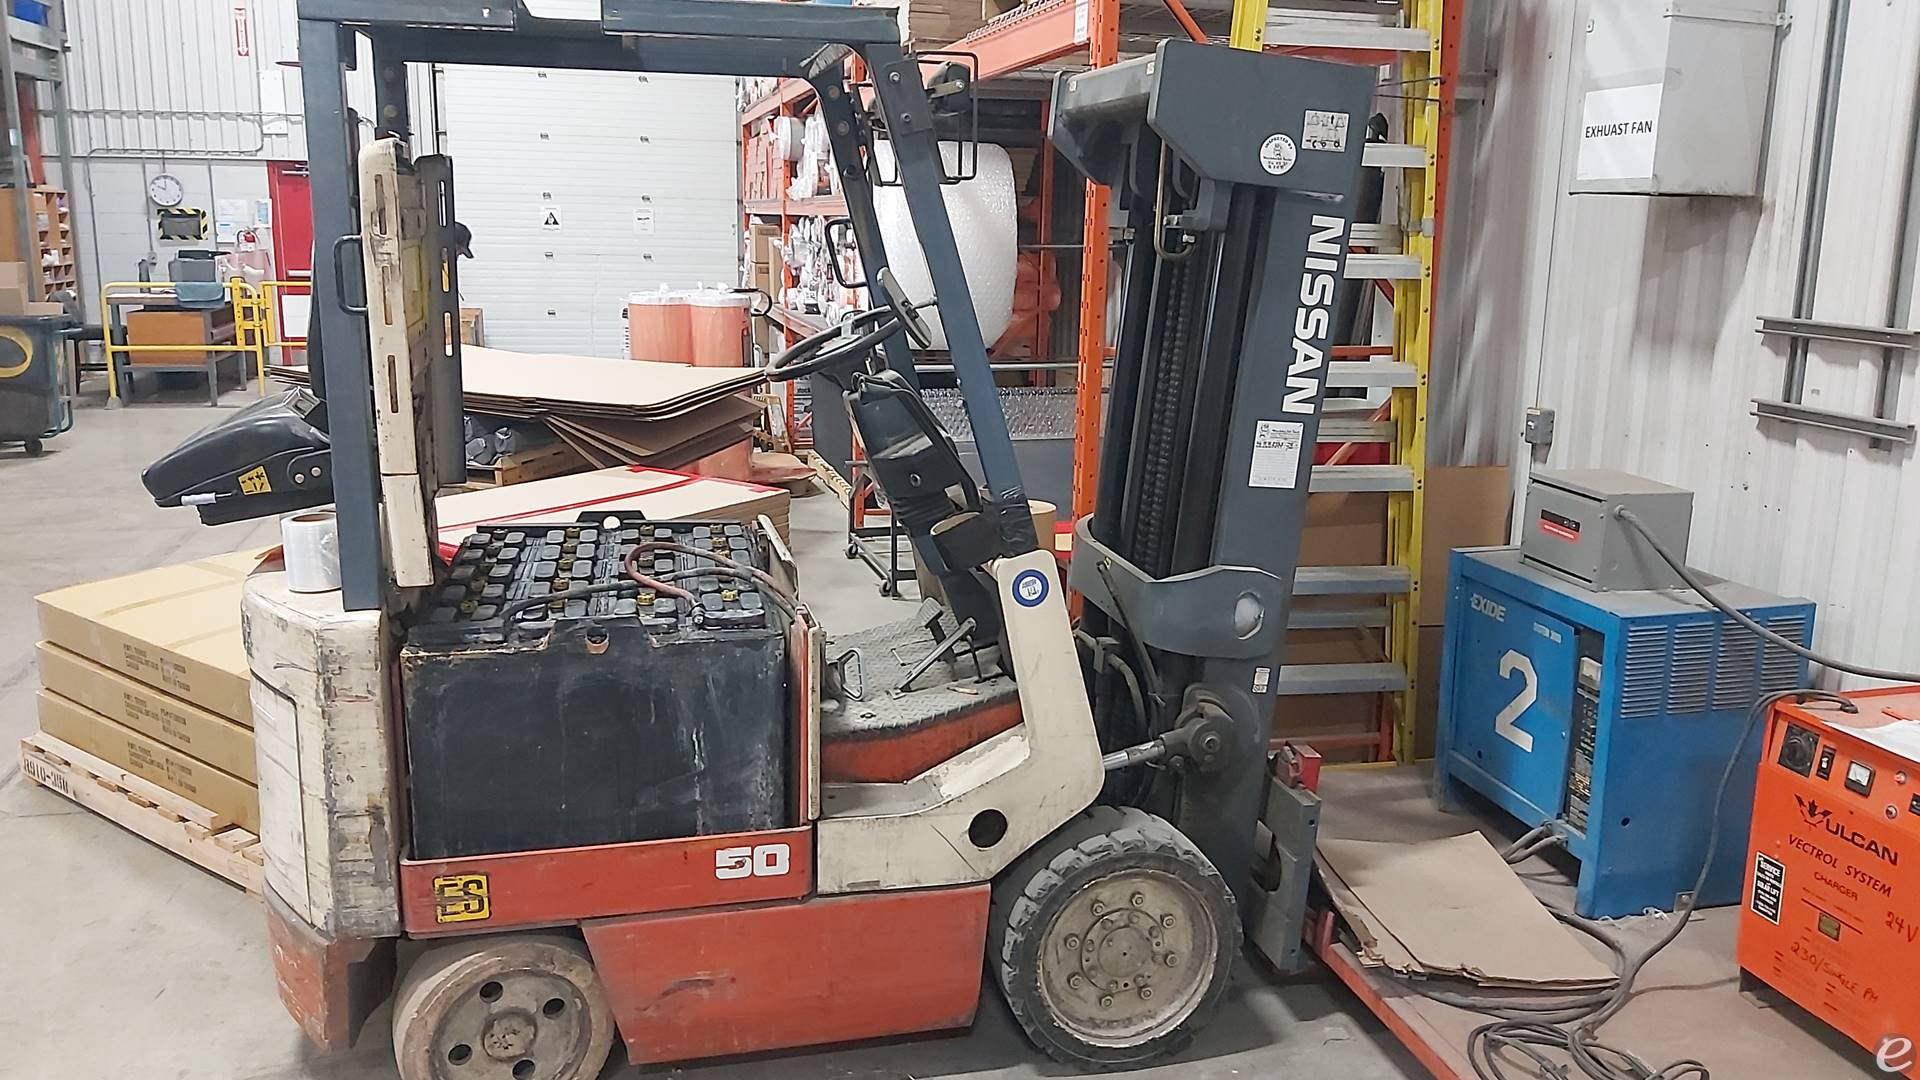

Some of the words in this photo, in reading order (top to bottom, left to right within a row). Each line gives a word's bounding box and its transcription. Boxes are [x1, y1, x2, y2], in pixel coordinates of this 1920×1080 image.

[1584, 122, 1630, 138] EXHUAST
[1630, 119, 1654, 135] FAN
[1281, 214, 1346, 415] NISSAN
[1470, 592, 1507, 623] EXIDE
[1495, 649, 1537, 752] 2
[715, 843, 790, 880] 50
[1788, 833, 1839, 869] VECTROL
[1844, 864, 1893, 898] SYSTEM
[1813, 871, 1859, 901] CHARGER
